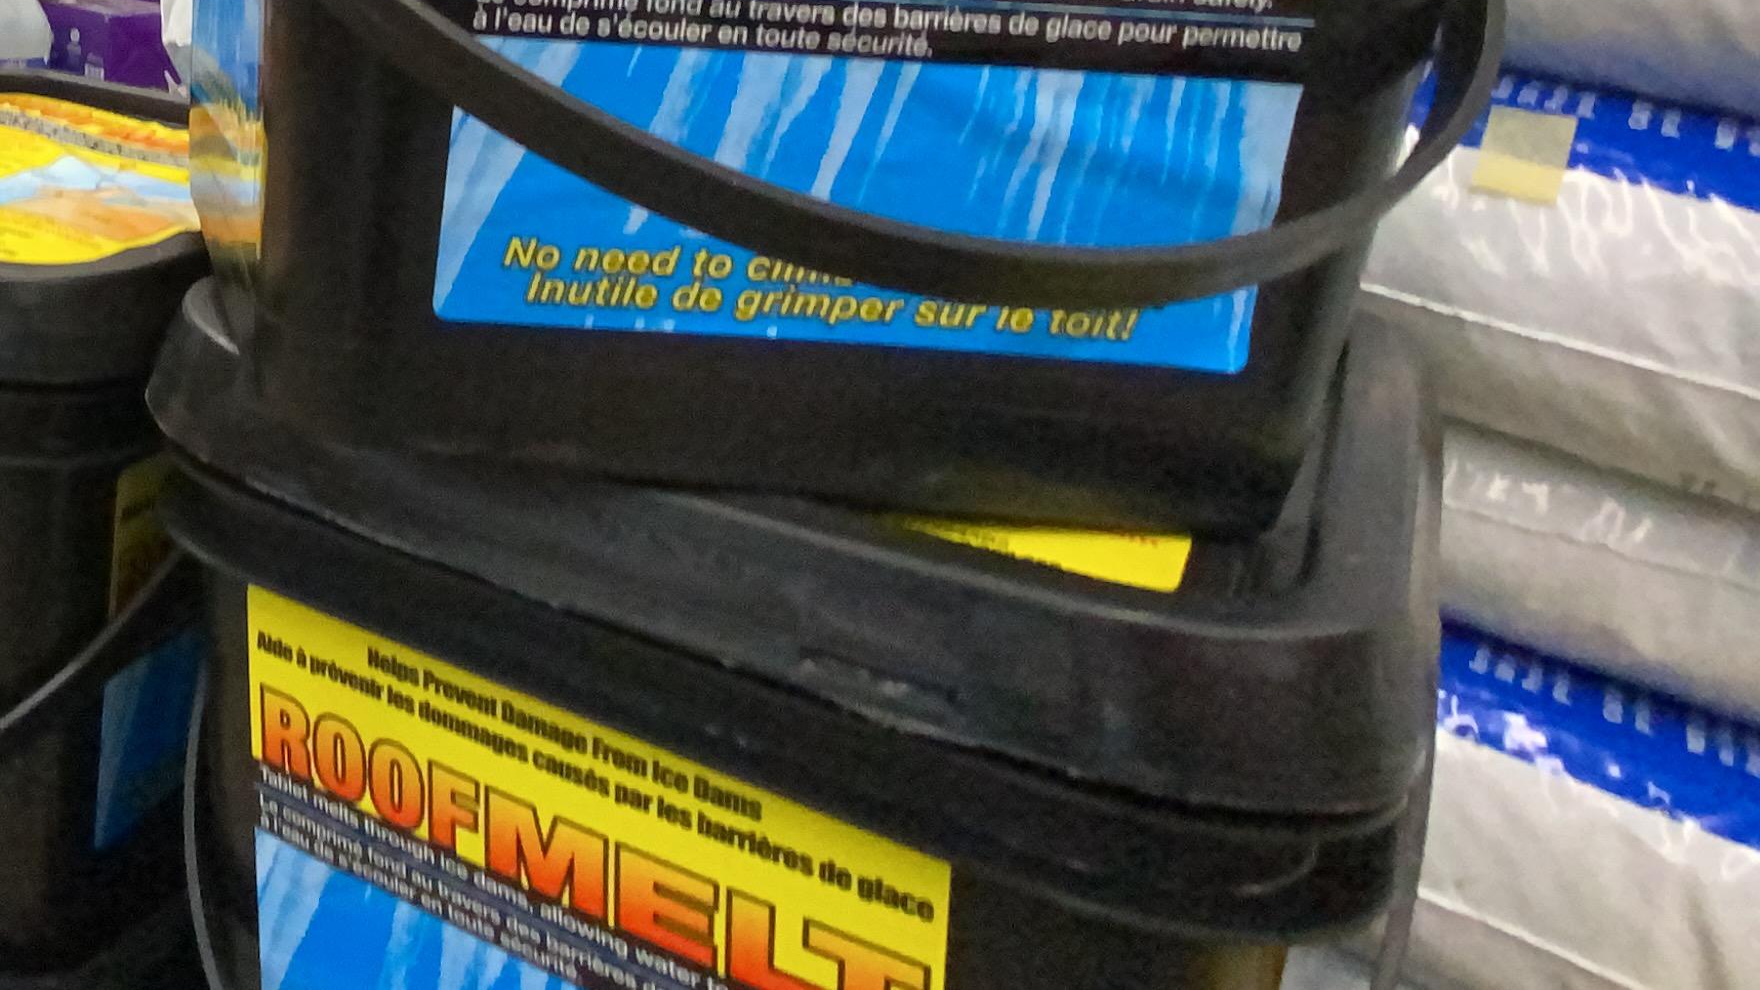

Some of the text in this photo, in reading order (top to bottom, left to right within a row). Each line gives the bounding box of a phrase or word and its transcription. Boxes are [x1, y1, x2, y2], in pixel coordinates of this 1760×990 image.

[472, 4, 488, 32] à
[494, 8, 553, 34] l'eau
[560, 11, 591, 37] de
[597, 13, 713, 43] s'écouler
[718, 24, 748, 45] en
[755, 23, 819, 50] toute
[842, 1, 887, 29] des
[893, 3, 1002, 35] barrières
[1008, 11, 1040, 37] de
[1045, 12, 1112, 44] glace
[1118, 20, 1178, 46] pour
[1183, 24, 1303, 53] permettre
[503, 236, 561, 270] No
[573, 245, 682, 277] need
[692, 249, 734, 279] to
[526, 273, 1139, 342] Inutile de grimper sur le toit!
[422, 668, 498, 718] Prevent
[592, 734, 648, 778] From
[651, 759, 690, 795] Ice
[693, 775, 763, 823] Dams
[259, 681, 932, 990] ROOFMELT
